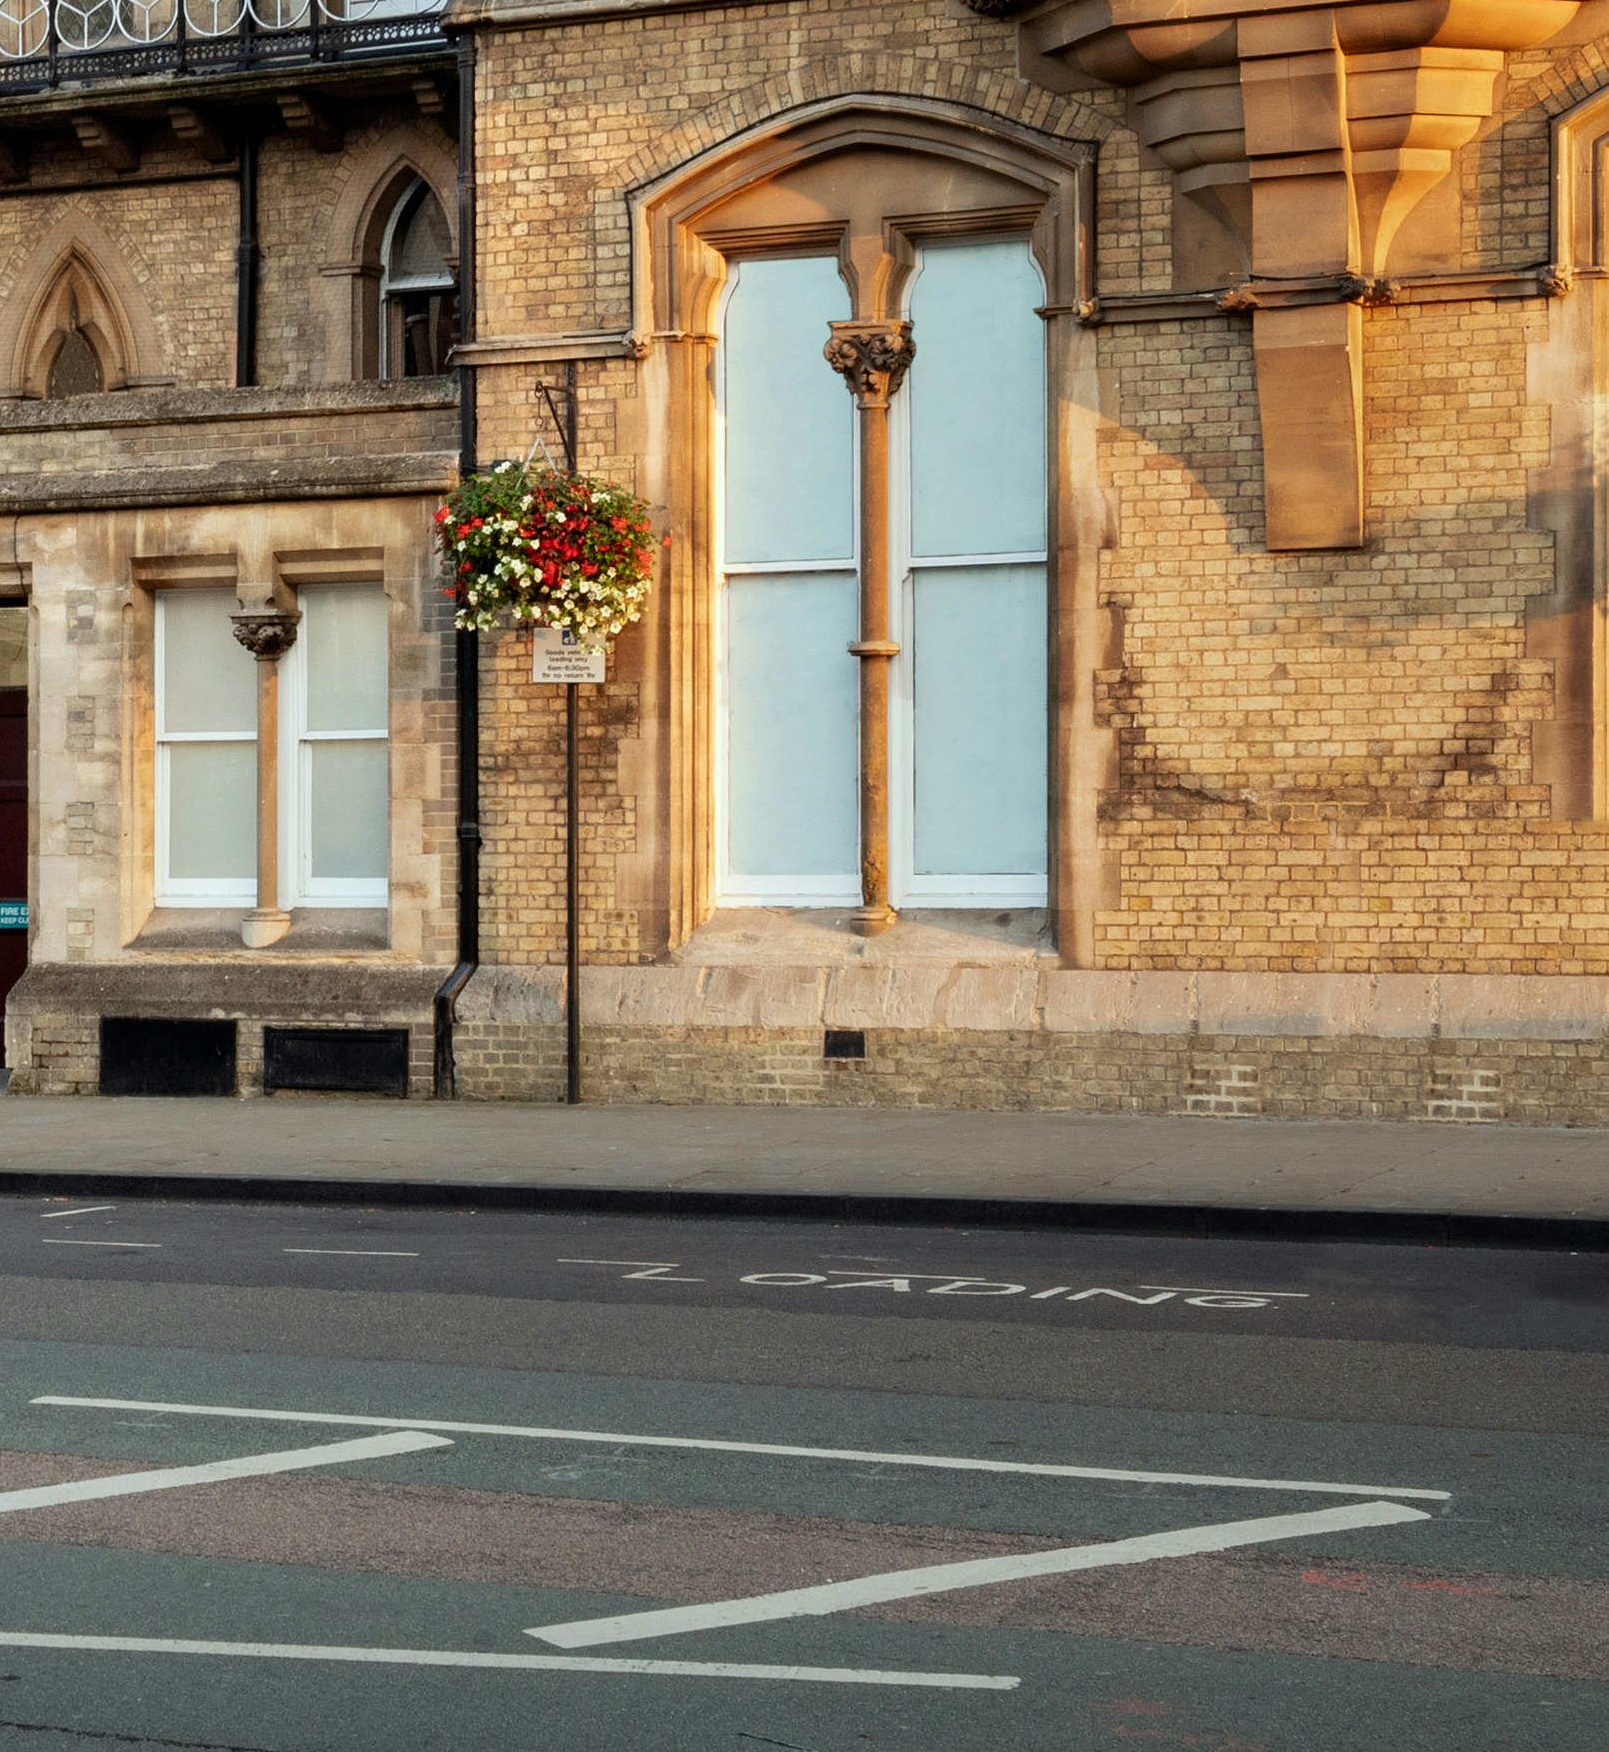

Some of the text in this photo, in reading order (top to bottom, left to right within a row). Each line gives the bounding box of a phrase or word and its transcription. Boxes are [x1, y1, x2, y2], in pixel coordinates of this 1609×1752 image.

[1, 906, 19, 915] FIRE
[1, 916, 17, 924] KEEP
[621, 1267, 1274, 1308] LOADING
